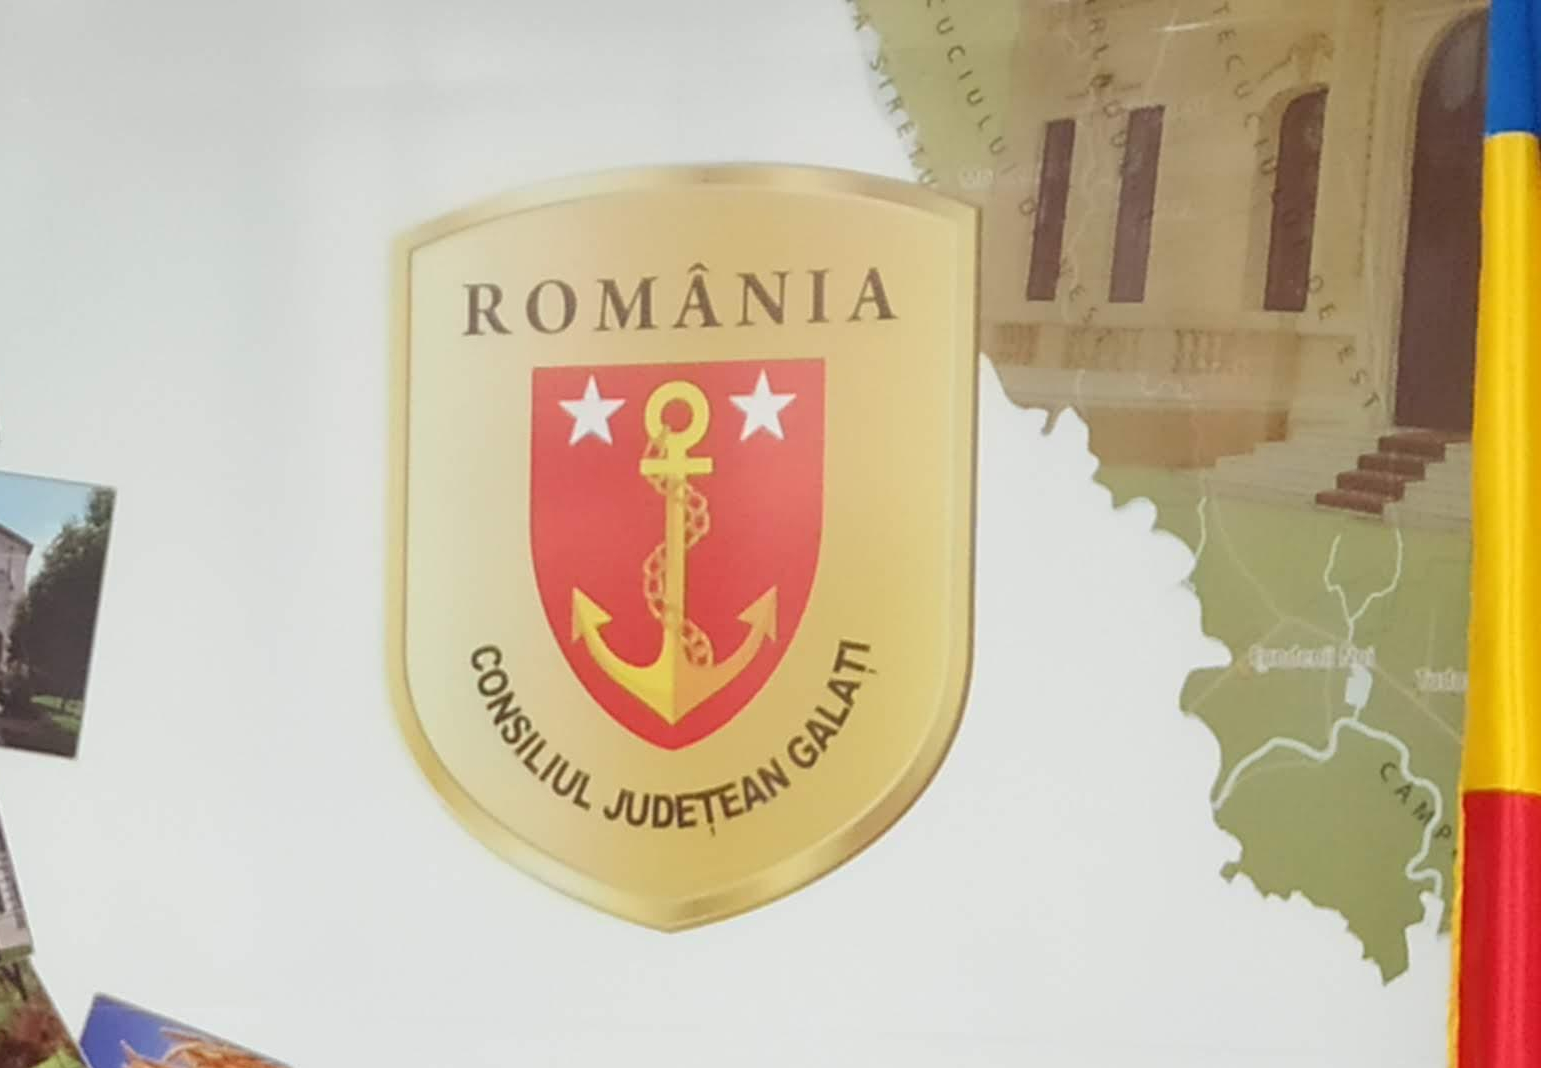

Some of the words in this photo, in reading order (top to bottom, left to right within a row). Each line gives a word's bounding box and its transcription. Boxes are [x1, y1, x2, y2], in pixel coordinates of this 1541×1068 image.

[462, 263, 898, 336] ROMÂNIA
[471, 644, 593, 811] CONSILIUL
[602, 757, 792, 837] JUDEȚEAN
[788, 638, 880, 771] GALAȚI
